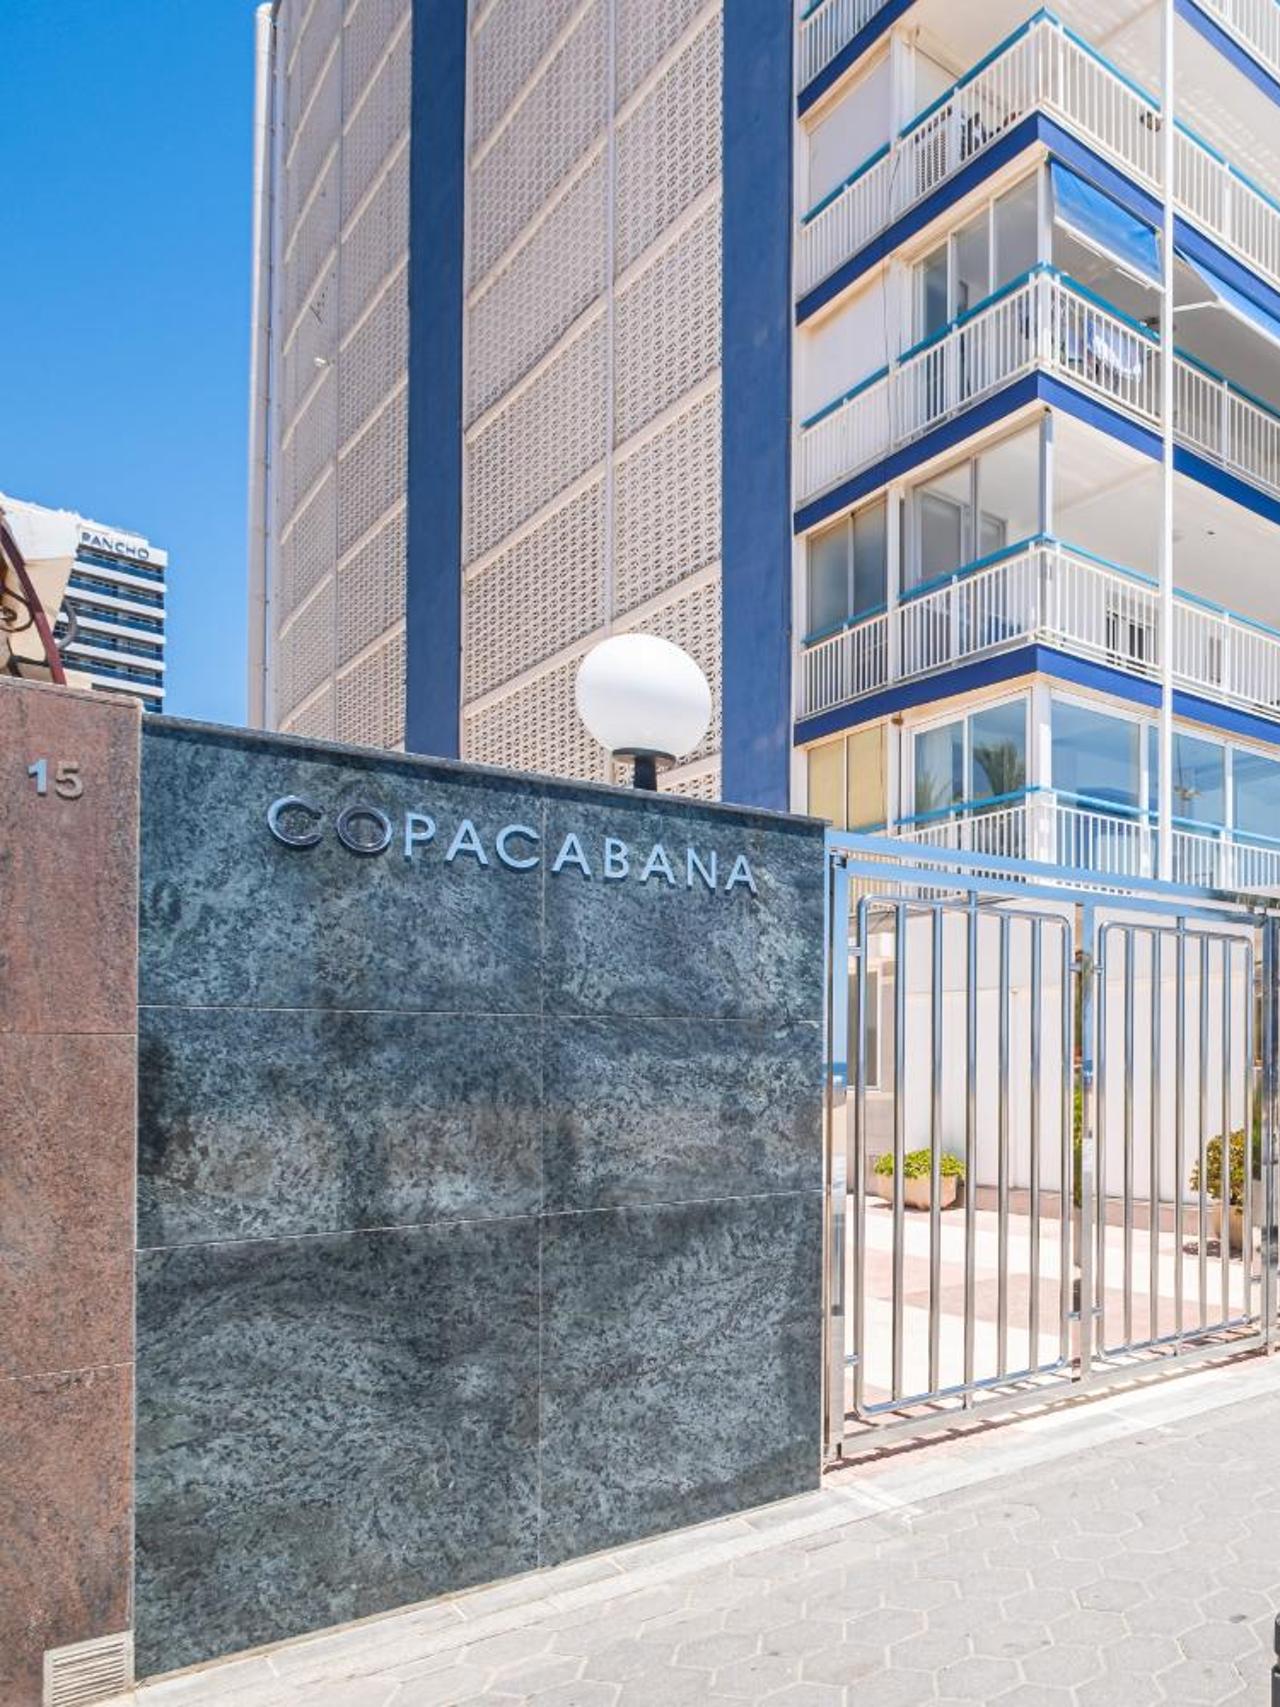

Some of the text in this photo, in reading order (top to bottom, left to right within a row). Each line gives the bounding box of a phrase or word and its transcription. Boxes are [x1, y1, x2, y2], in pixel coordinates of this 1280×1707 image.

[81, 531, 150, 561] PANCHO
[26, 758, 84, 799] 15
[266, 795, 758, 894] COPACABANA
